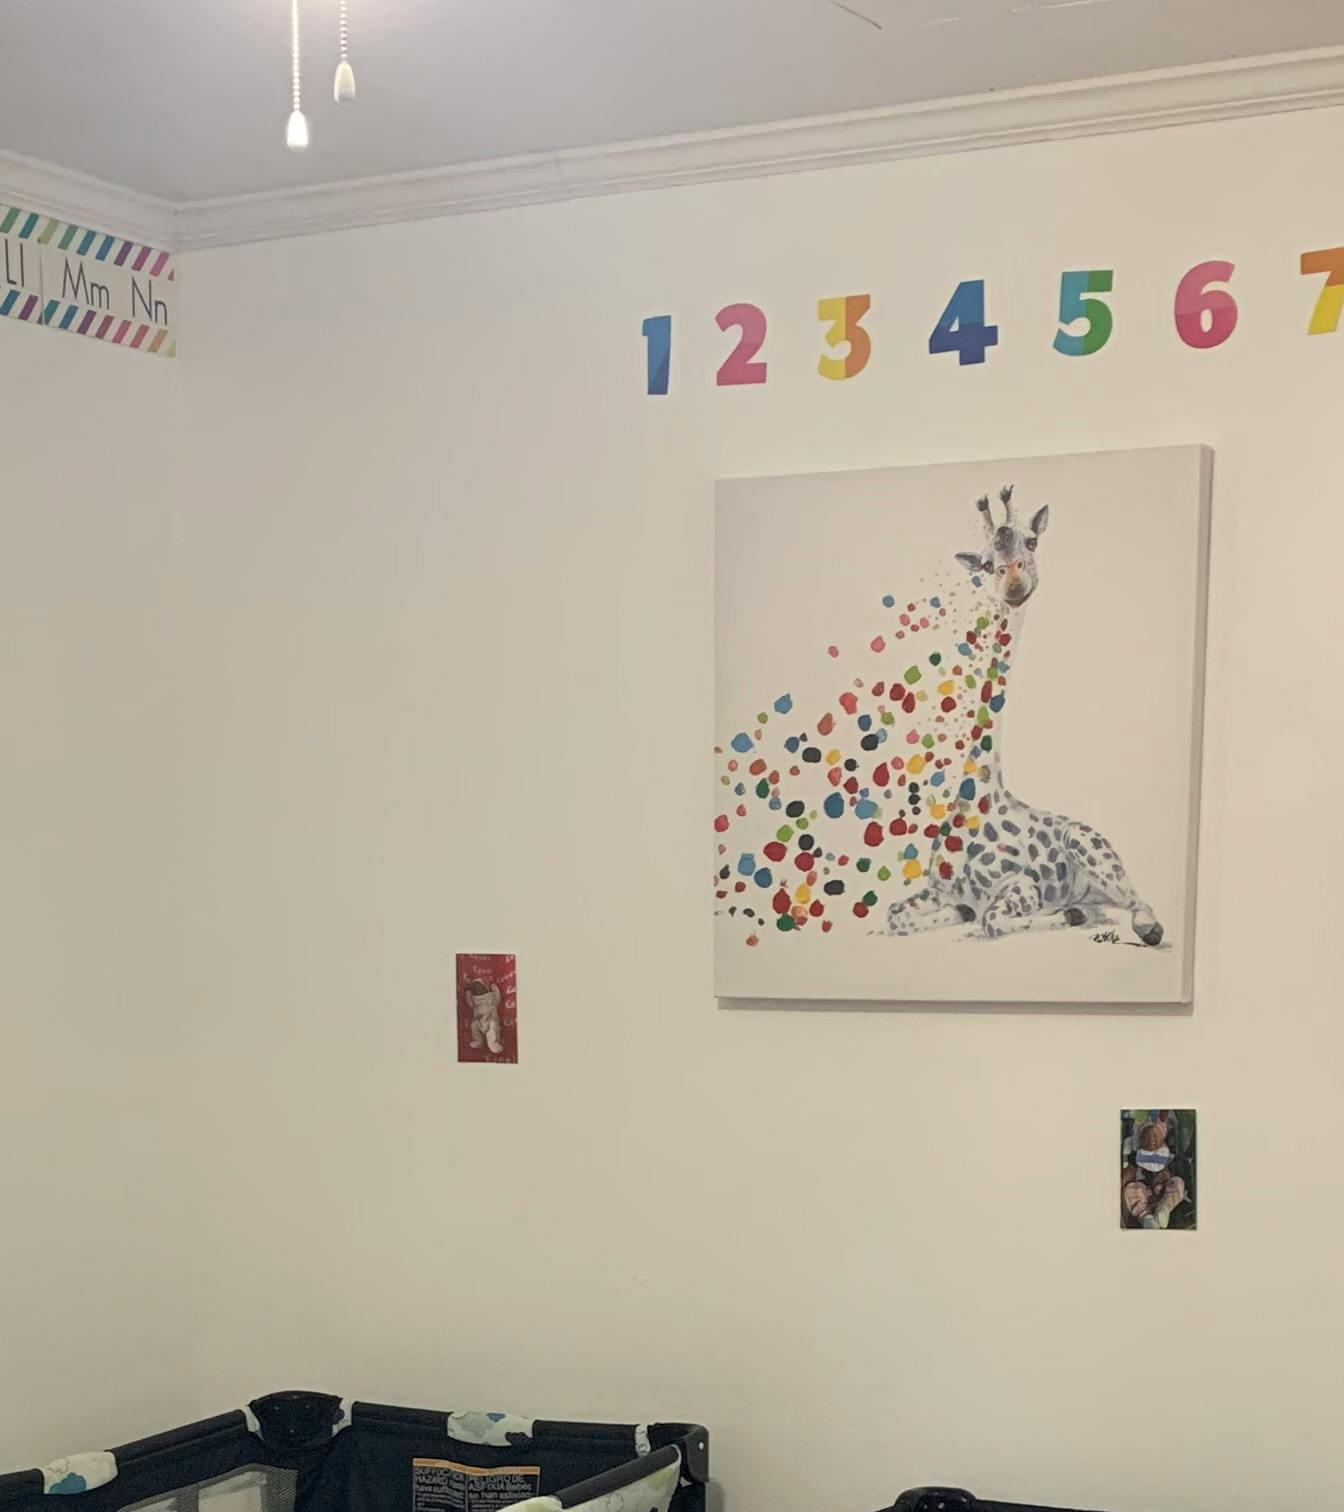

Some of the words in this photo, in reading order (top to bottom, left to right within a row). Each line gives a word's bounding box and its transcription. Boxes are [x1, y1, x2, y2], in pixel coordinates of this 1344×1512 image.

[4, 238, 25, 289] Ll
[62, 258, 111, 312] Mm
[131, 277, 169, 326] Nn
[642, 315, 672, 396] 1
[715, 302, 768, 387] 2
[817, 293, 872, 382] 3
[928, 279, 999, 366] 4
[1052, 269, 1114, 357] 5
[1174, 260, 1239, 349] 6
